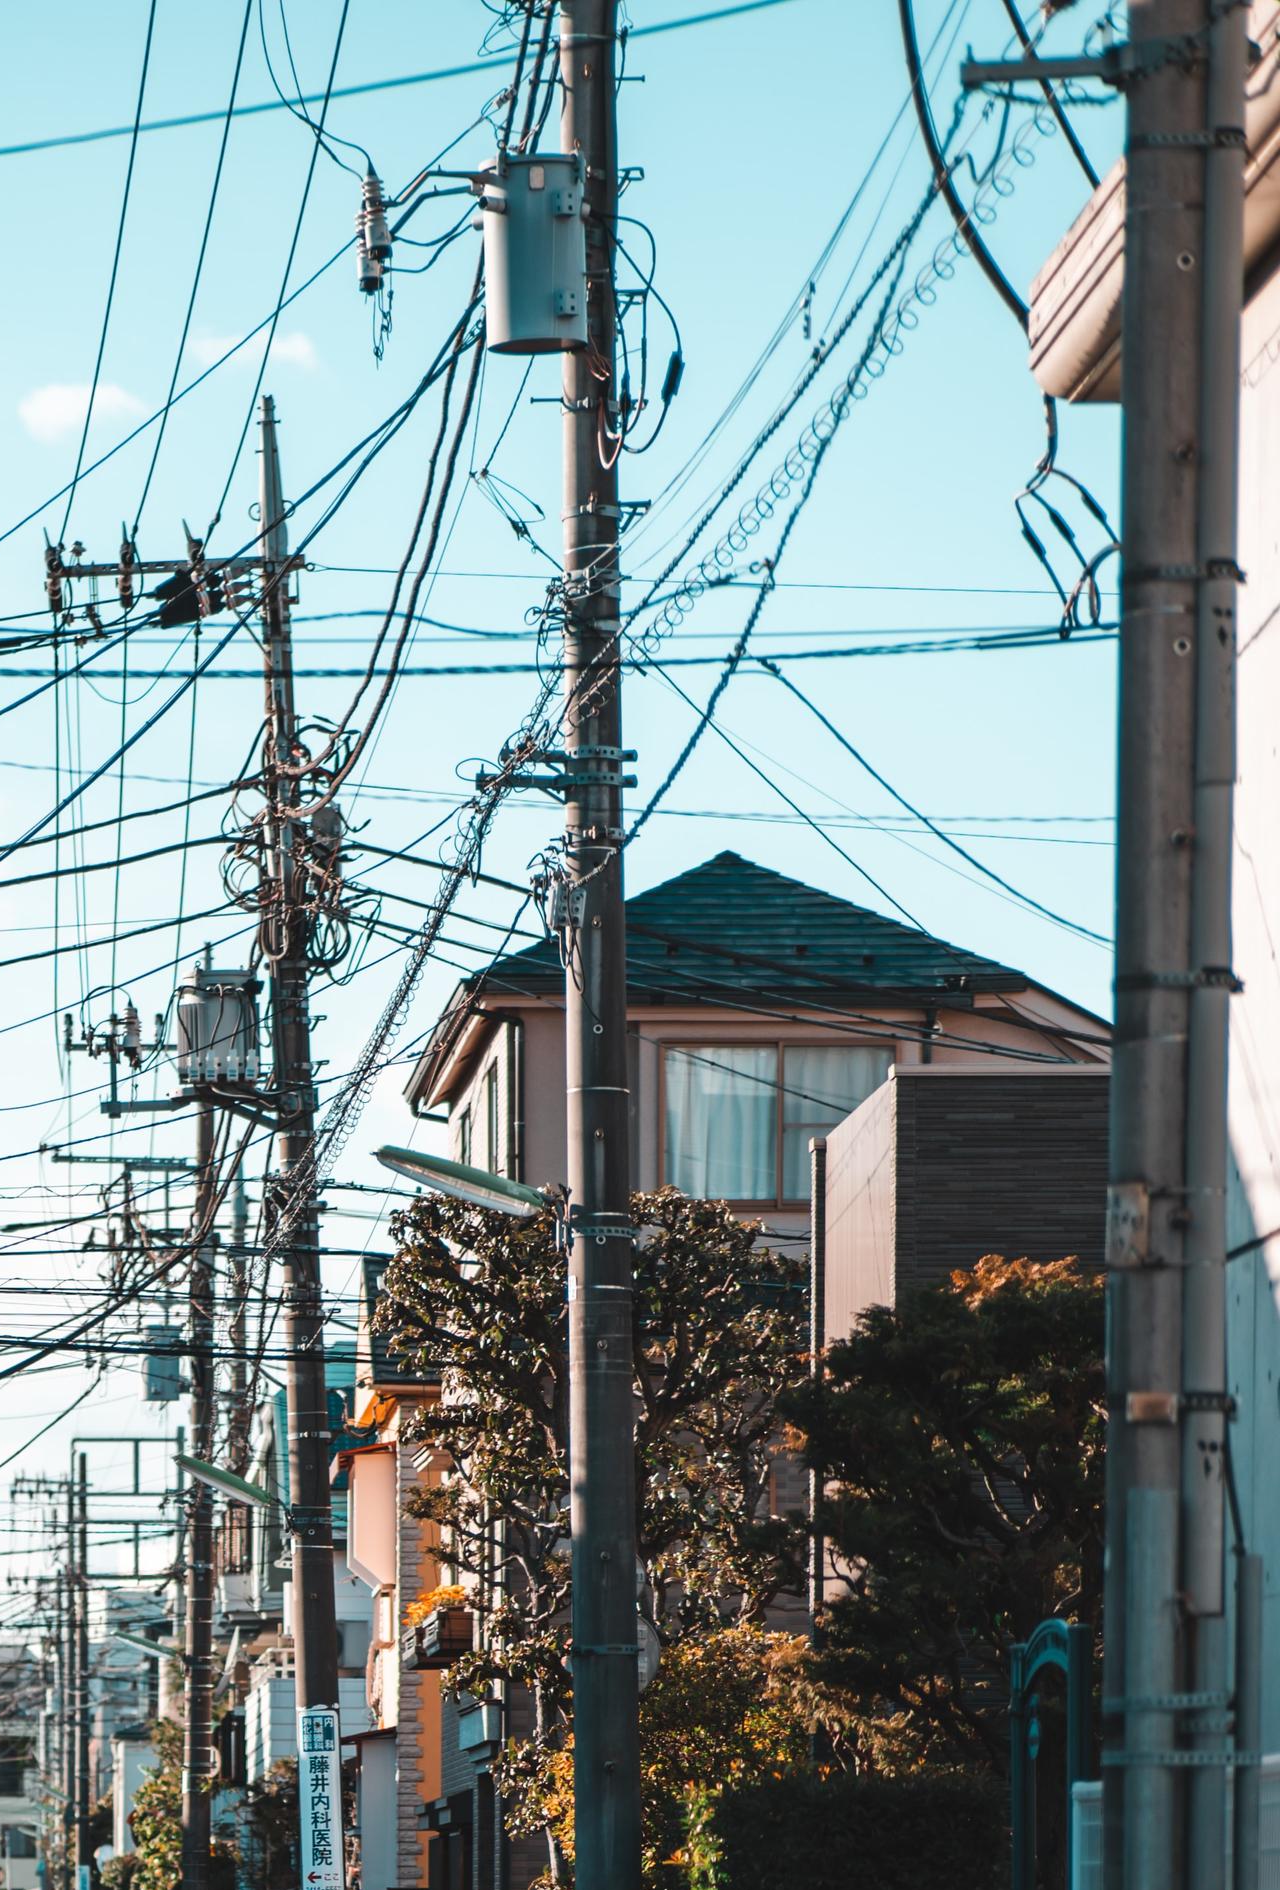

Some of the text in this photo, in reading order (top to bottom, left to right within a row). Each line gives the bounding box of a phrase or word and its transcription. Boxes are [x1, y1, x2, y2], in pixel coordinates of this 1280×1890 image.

[324, 1716, 334, 1750] 内科
[309, 1756, 333, 1867] 藤井内科医院
[324, 1873, 339, 1881] ここ
